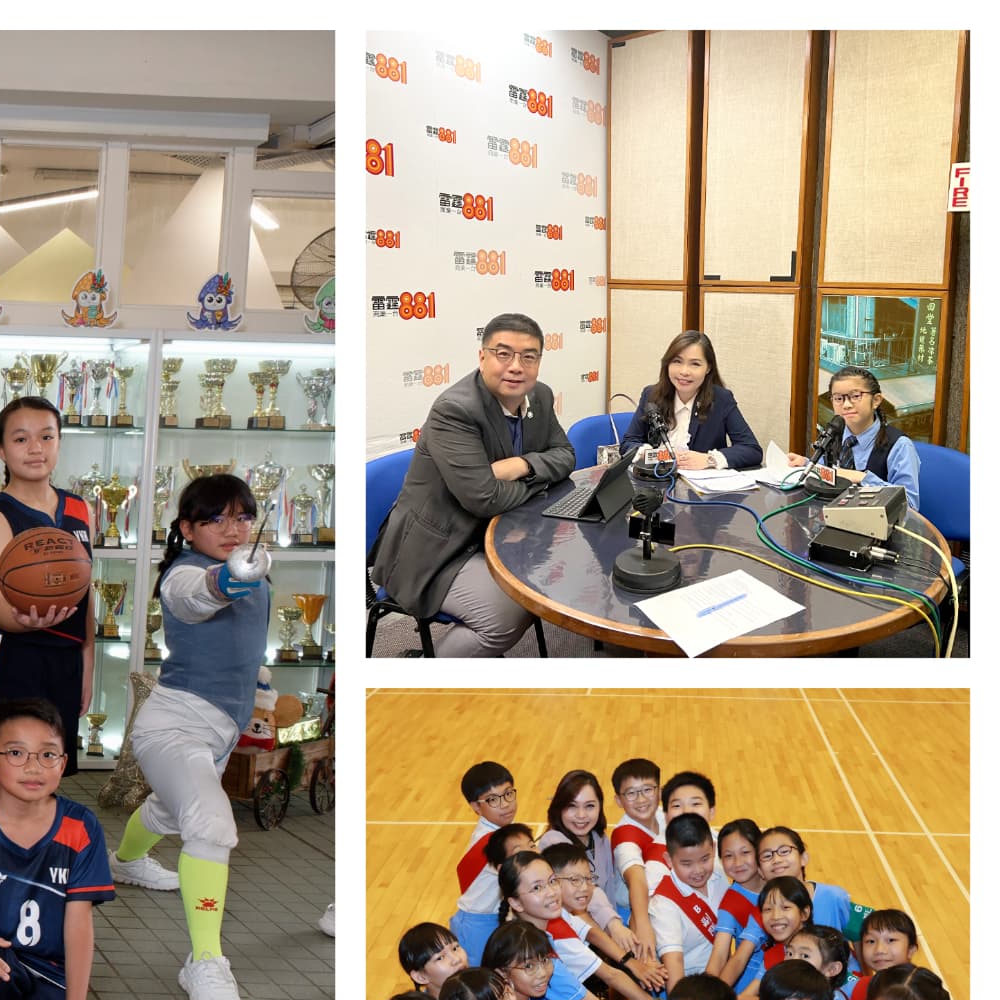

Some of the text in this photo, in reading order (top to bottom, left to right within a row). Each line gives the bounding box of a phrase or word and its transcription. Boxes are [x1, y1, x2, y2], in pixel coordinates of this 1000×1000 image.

[375, 53, 408, 85] 881
[527, 88, 553, 119] 881
[438, 127, 457, 144] 881
[509, 137, 538, 169] 881
[462, 193, 494, 222] 881
[375, 229, 401, 249] 881
[476, 249, 506, 276] 881
[551, 268, 575, 291] 881
[399, 291, 436, 320] 881
[422, 362, 450, 388] 881
[48, 866, 67, 884] YK
[16, 899, 41, 947] 8
